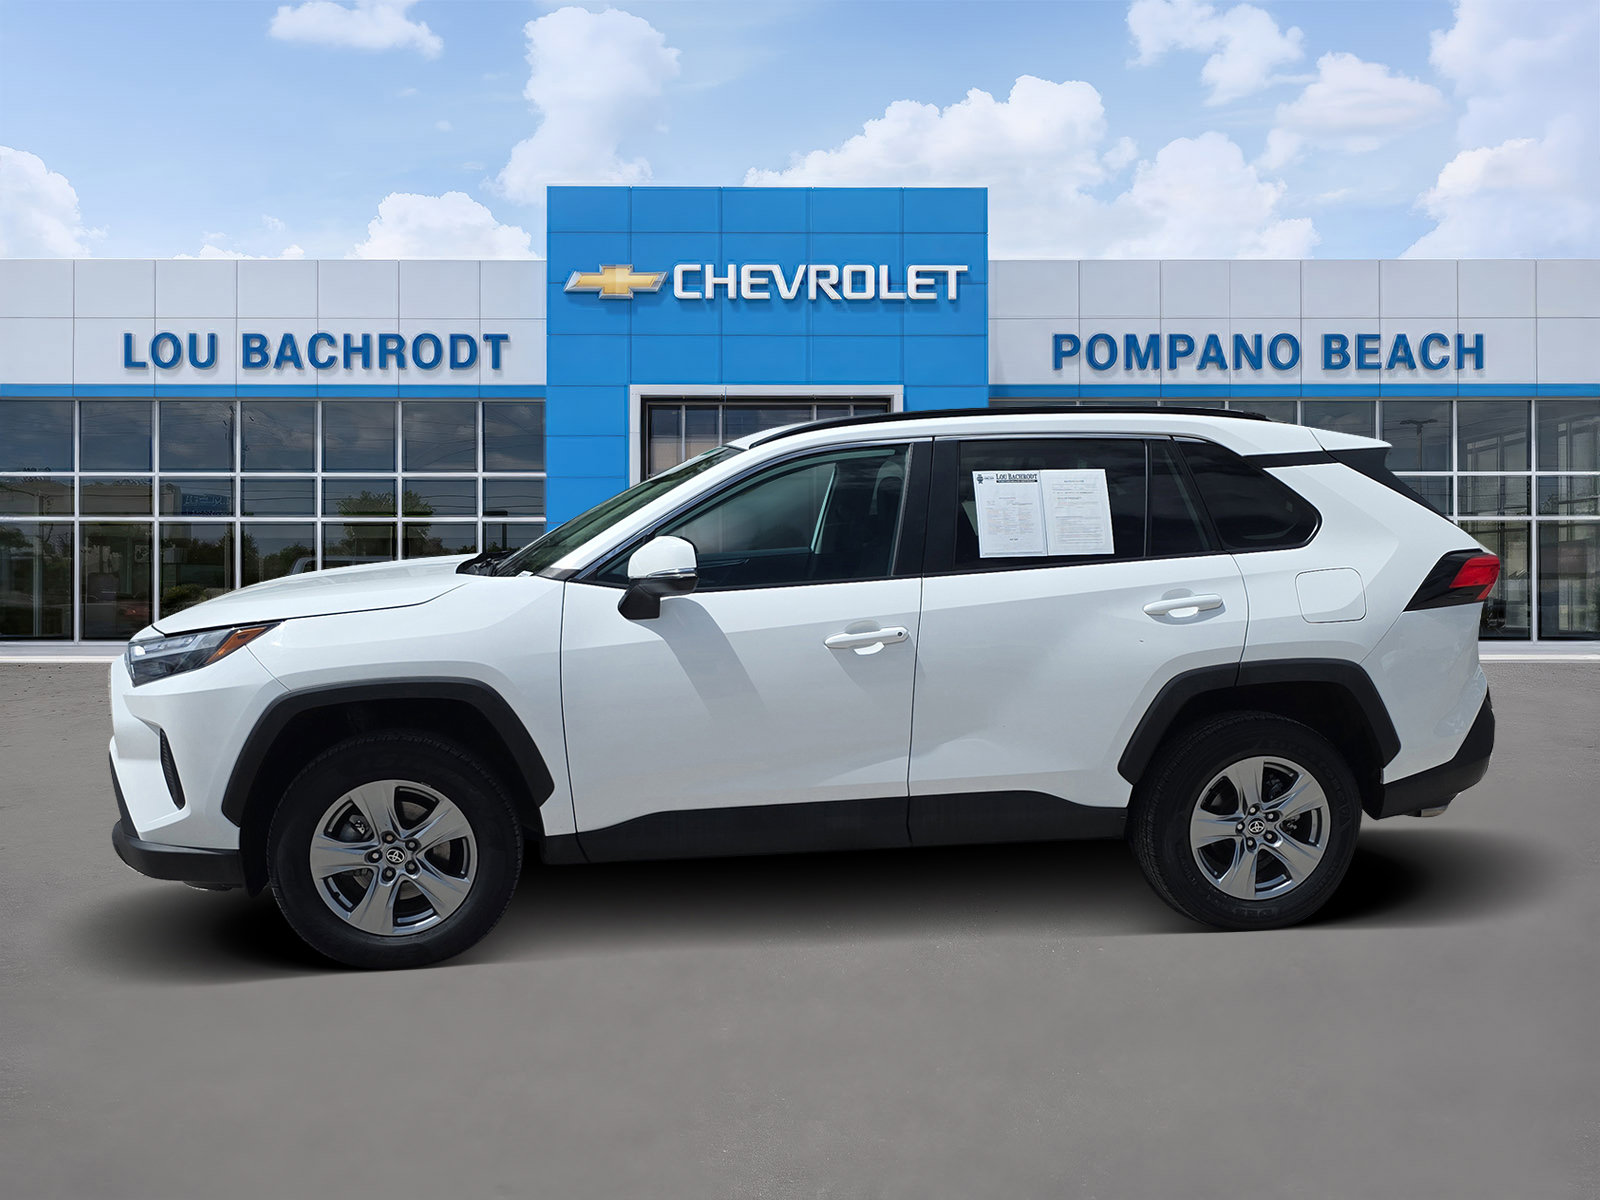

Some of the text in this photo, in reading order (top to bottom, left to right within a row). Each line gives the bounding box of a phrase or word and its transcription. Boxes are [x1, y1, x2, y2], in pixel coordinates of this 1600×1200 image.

[673, 264, 969, 301] CHEVROLET
[123, 332, 510, 371] LOU BACHRODT
[1052, 333, 1485, 371] POMPANO BEACH
